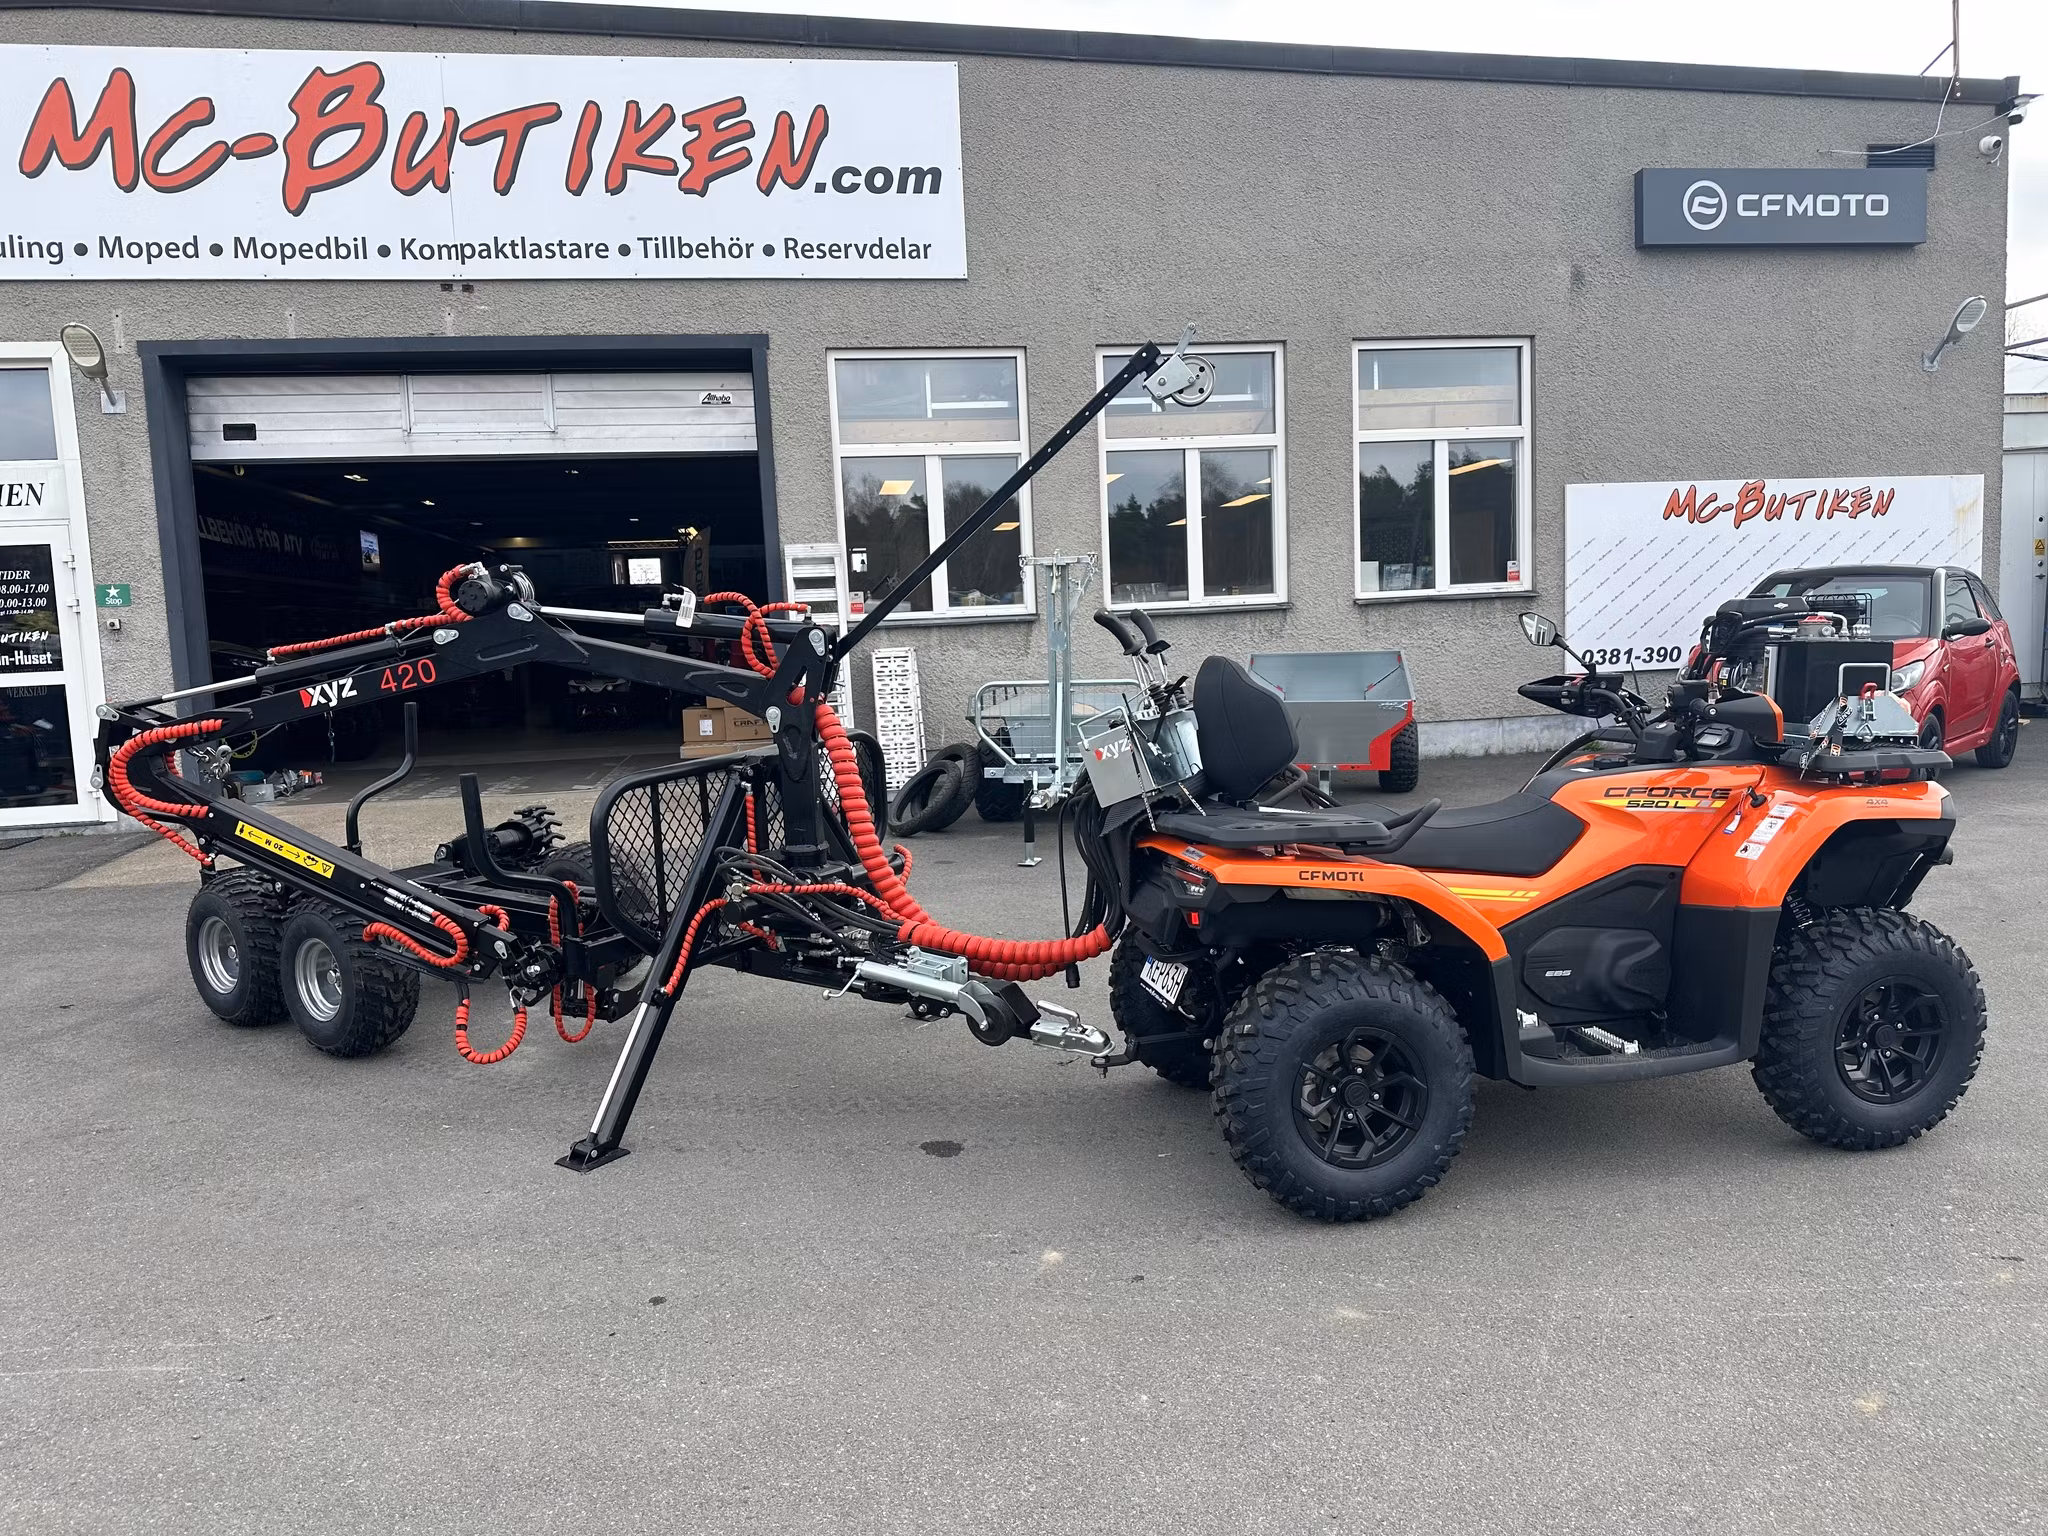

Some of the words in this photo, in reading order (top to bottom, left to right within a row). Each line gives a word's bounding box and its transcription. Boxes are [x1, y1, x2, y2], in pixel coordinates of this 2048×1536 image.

[1736, 193, 1889, 217] CFMOTO
[98, 235, 200, 265] Moped
[233, 236, 368, 265] Mopedbil
[401, 238, 610, 265] Kompaktlastare
[637, 236, 754, 260] Tillbehör
[784, 237, 932, 260] Reservdelar
[0, 583, 50, 594] 8.00-17.00
[105, 597, 123, 606] Stop
[1581, 645, 1683, 666] 0381-390
[304, 677, 358, 707] xyz
[381, 658, 437, 692] 420
[1604, 786, 1733, 800] CFORCE
[1626, 800, 1671, 809] 520
[1672, 801, 1687, 810] L
[264, 838, 272, 847] M
[273, 842, 284, 852] 20
